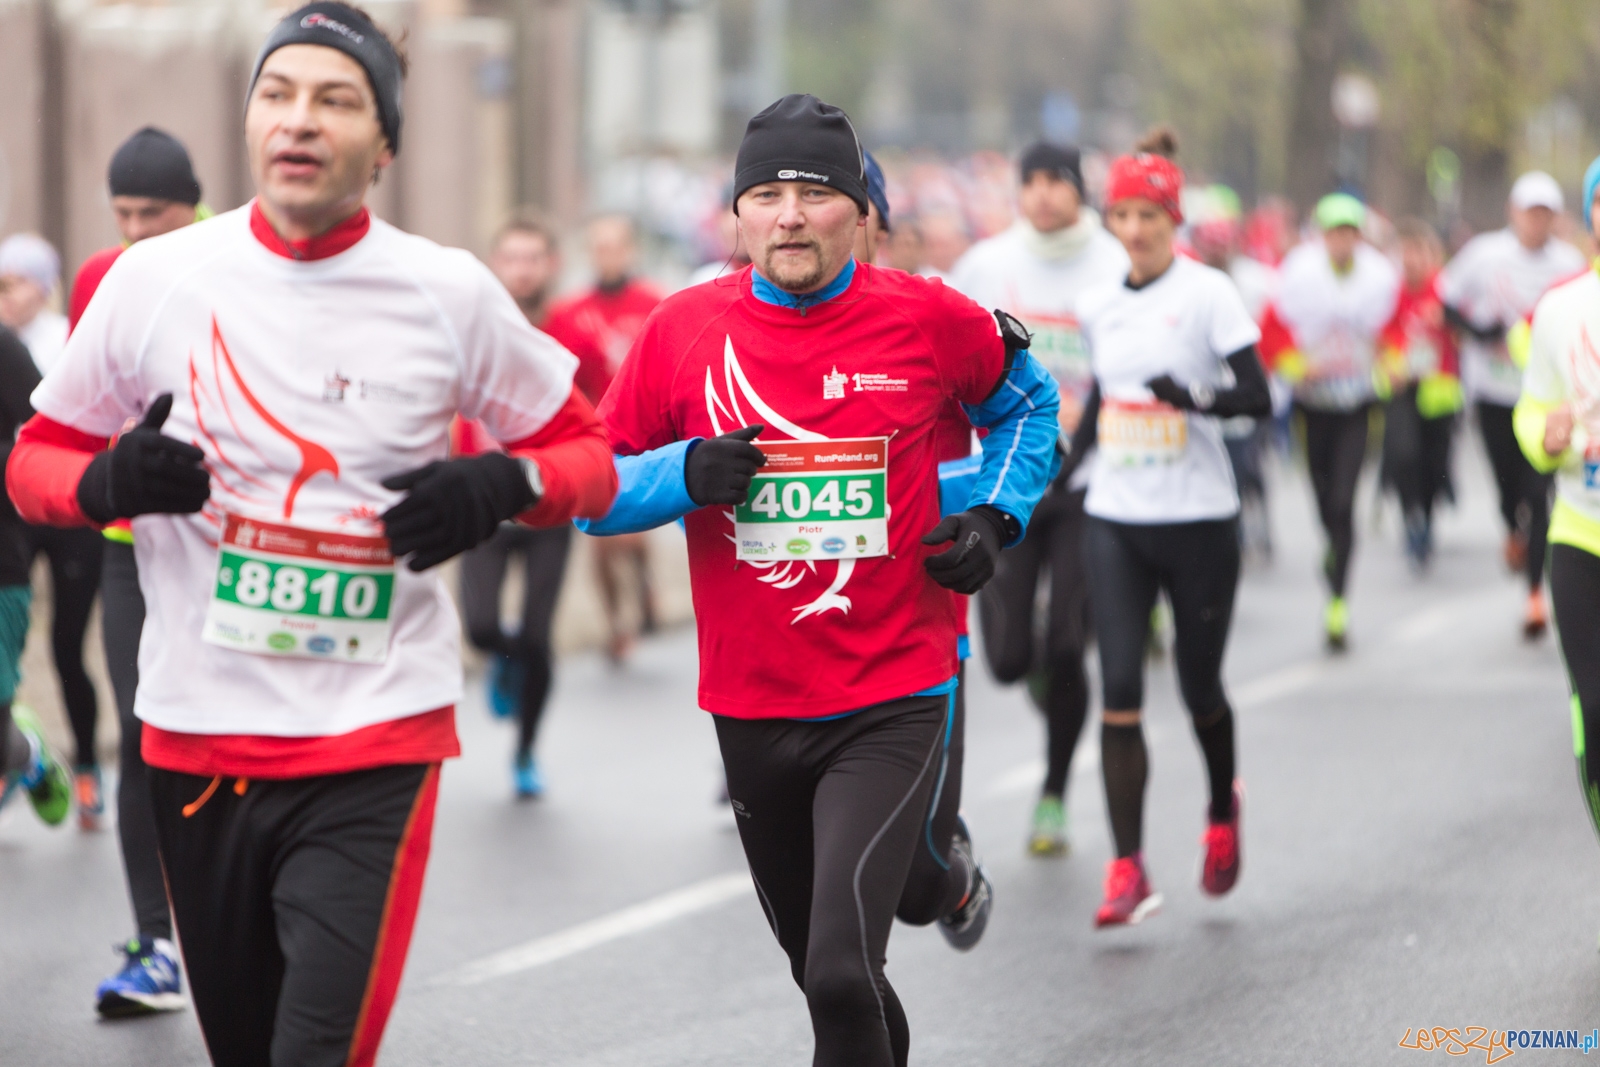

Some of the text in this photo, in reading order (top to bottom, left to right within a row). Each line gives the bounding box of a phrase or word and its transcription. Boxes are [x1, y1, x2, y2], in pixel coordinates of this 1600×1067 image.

[851, 372, 864, 392] 1
[814, 453, 878, 463] RunPoland.org
[751, 479, 873, 519] 4045
[798, 526, 823, 534] Piotr
[742, 540, 764, 548] GRUPA
[234, 559, 379, 619] 8810
